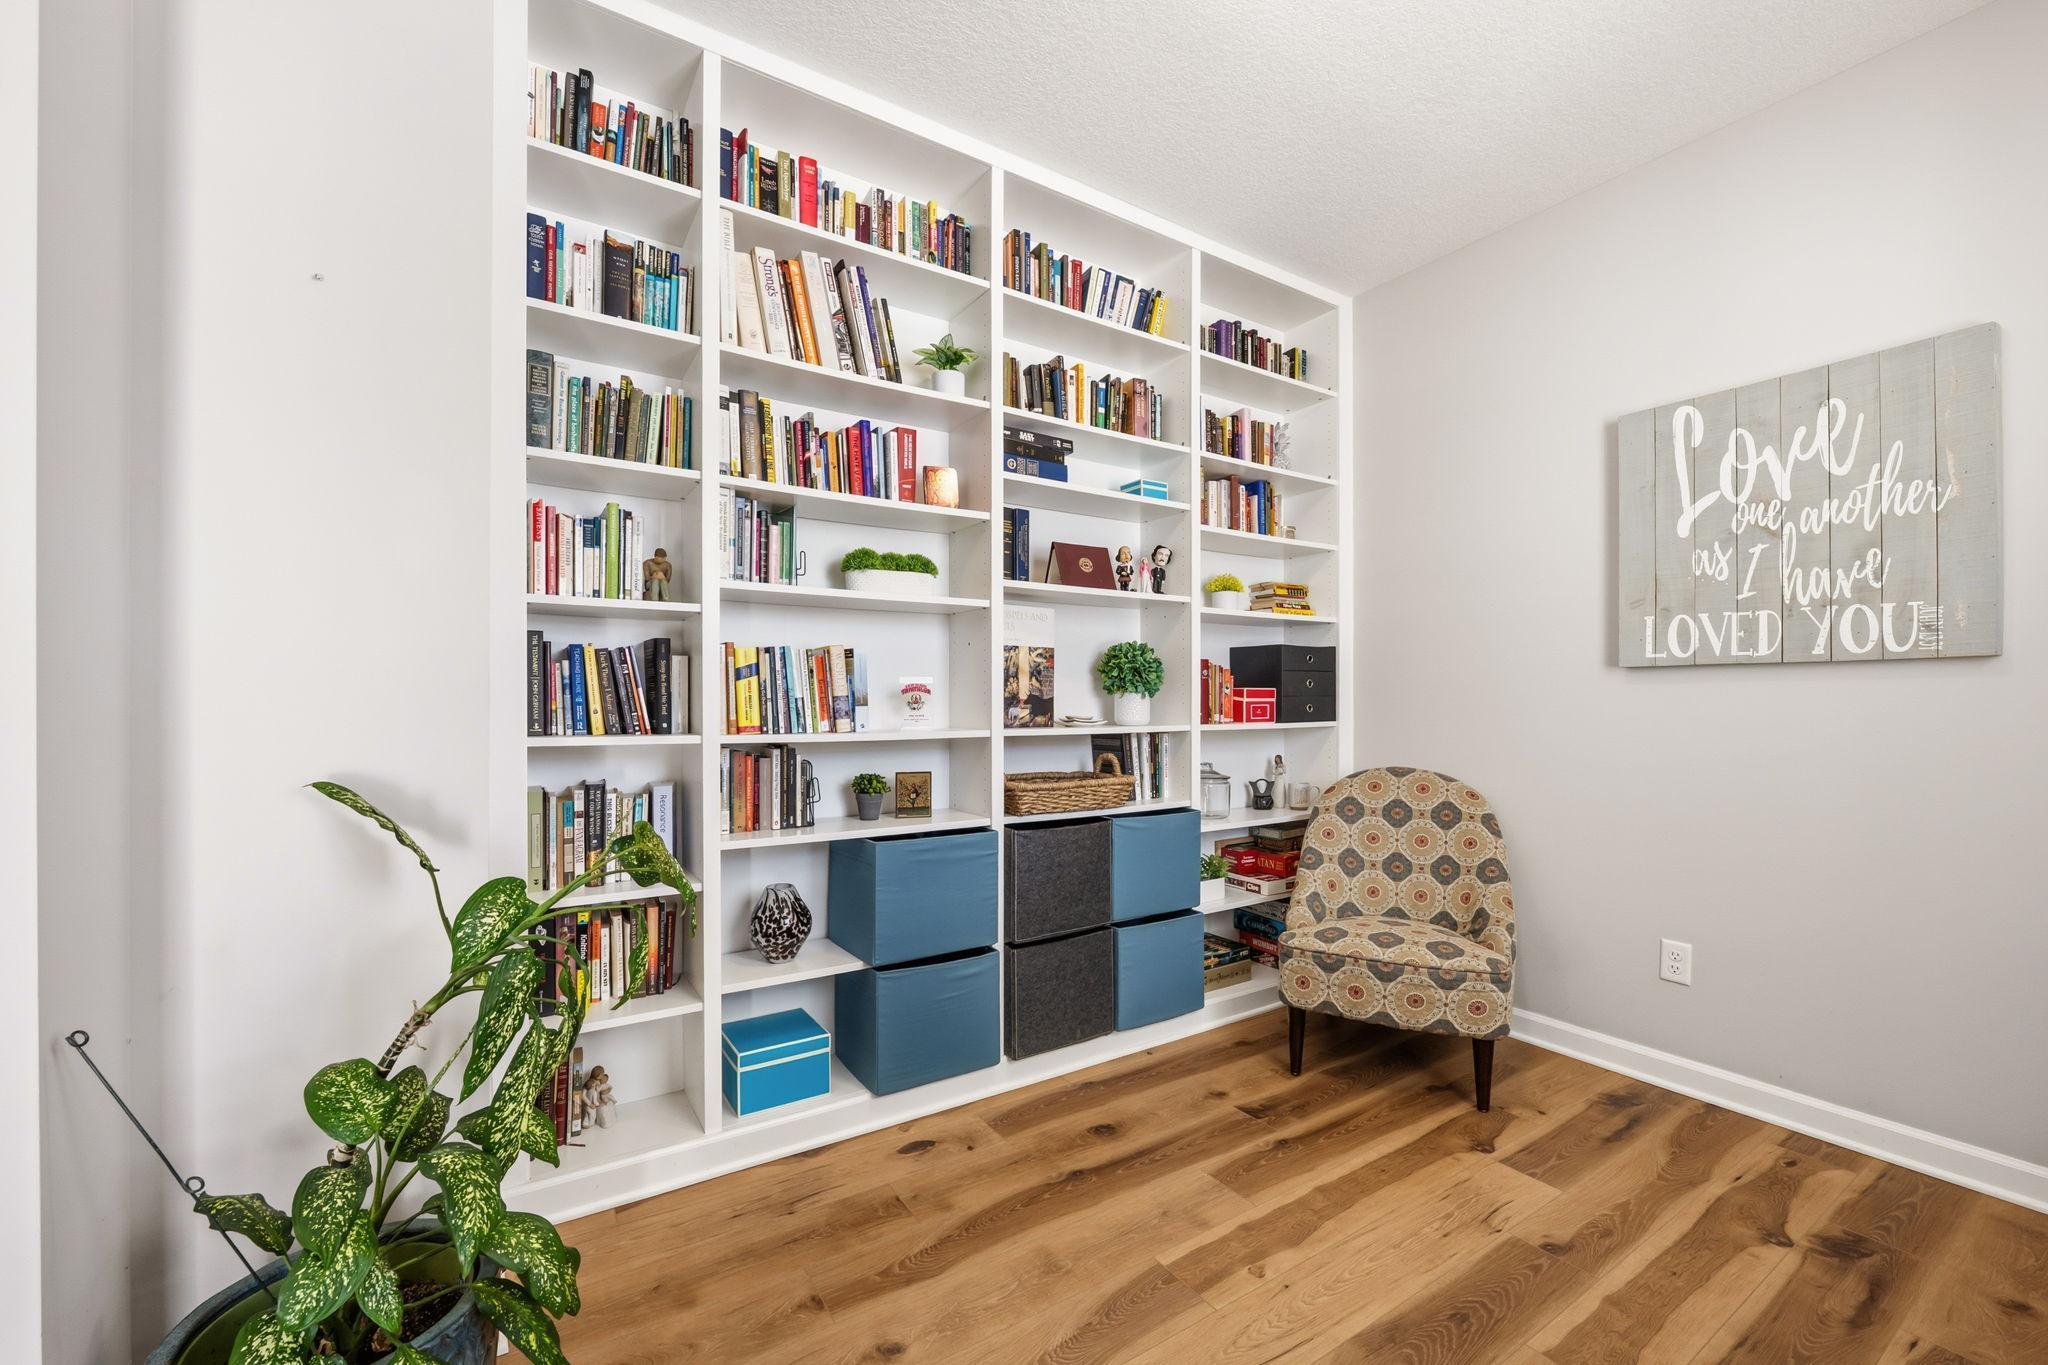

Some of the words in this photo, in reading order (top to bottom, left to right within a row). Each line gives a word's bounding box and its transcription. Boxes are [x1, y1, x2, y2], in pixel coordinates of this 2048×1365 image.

[758, 256, 778, 298] Strong's
[1671, 397, 1865, 539] Love
[1731, 497, 1785, 534] one
[1800, 440, 1958, 534] another
[1691, 540, 1733, 581] as
[1737, 543, 1770, 600] I
[1782, 521, 1891, 606] have
[1644, 609, 1782, 659] LOVED
[1799, 601, 1924, 655] YOU
[599, 651, 608, 668] Dark
[602, 668, 610, 687] Things
[659, 794, 667, 833] Resonance
